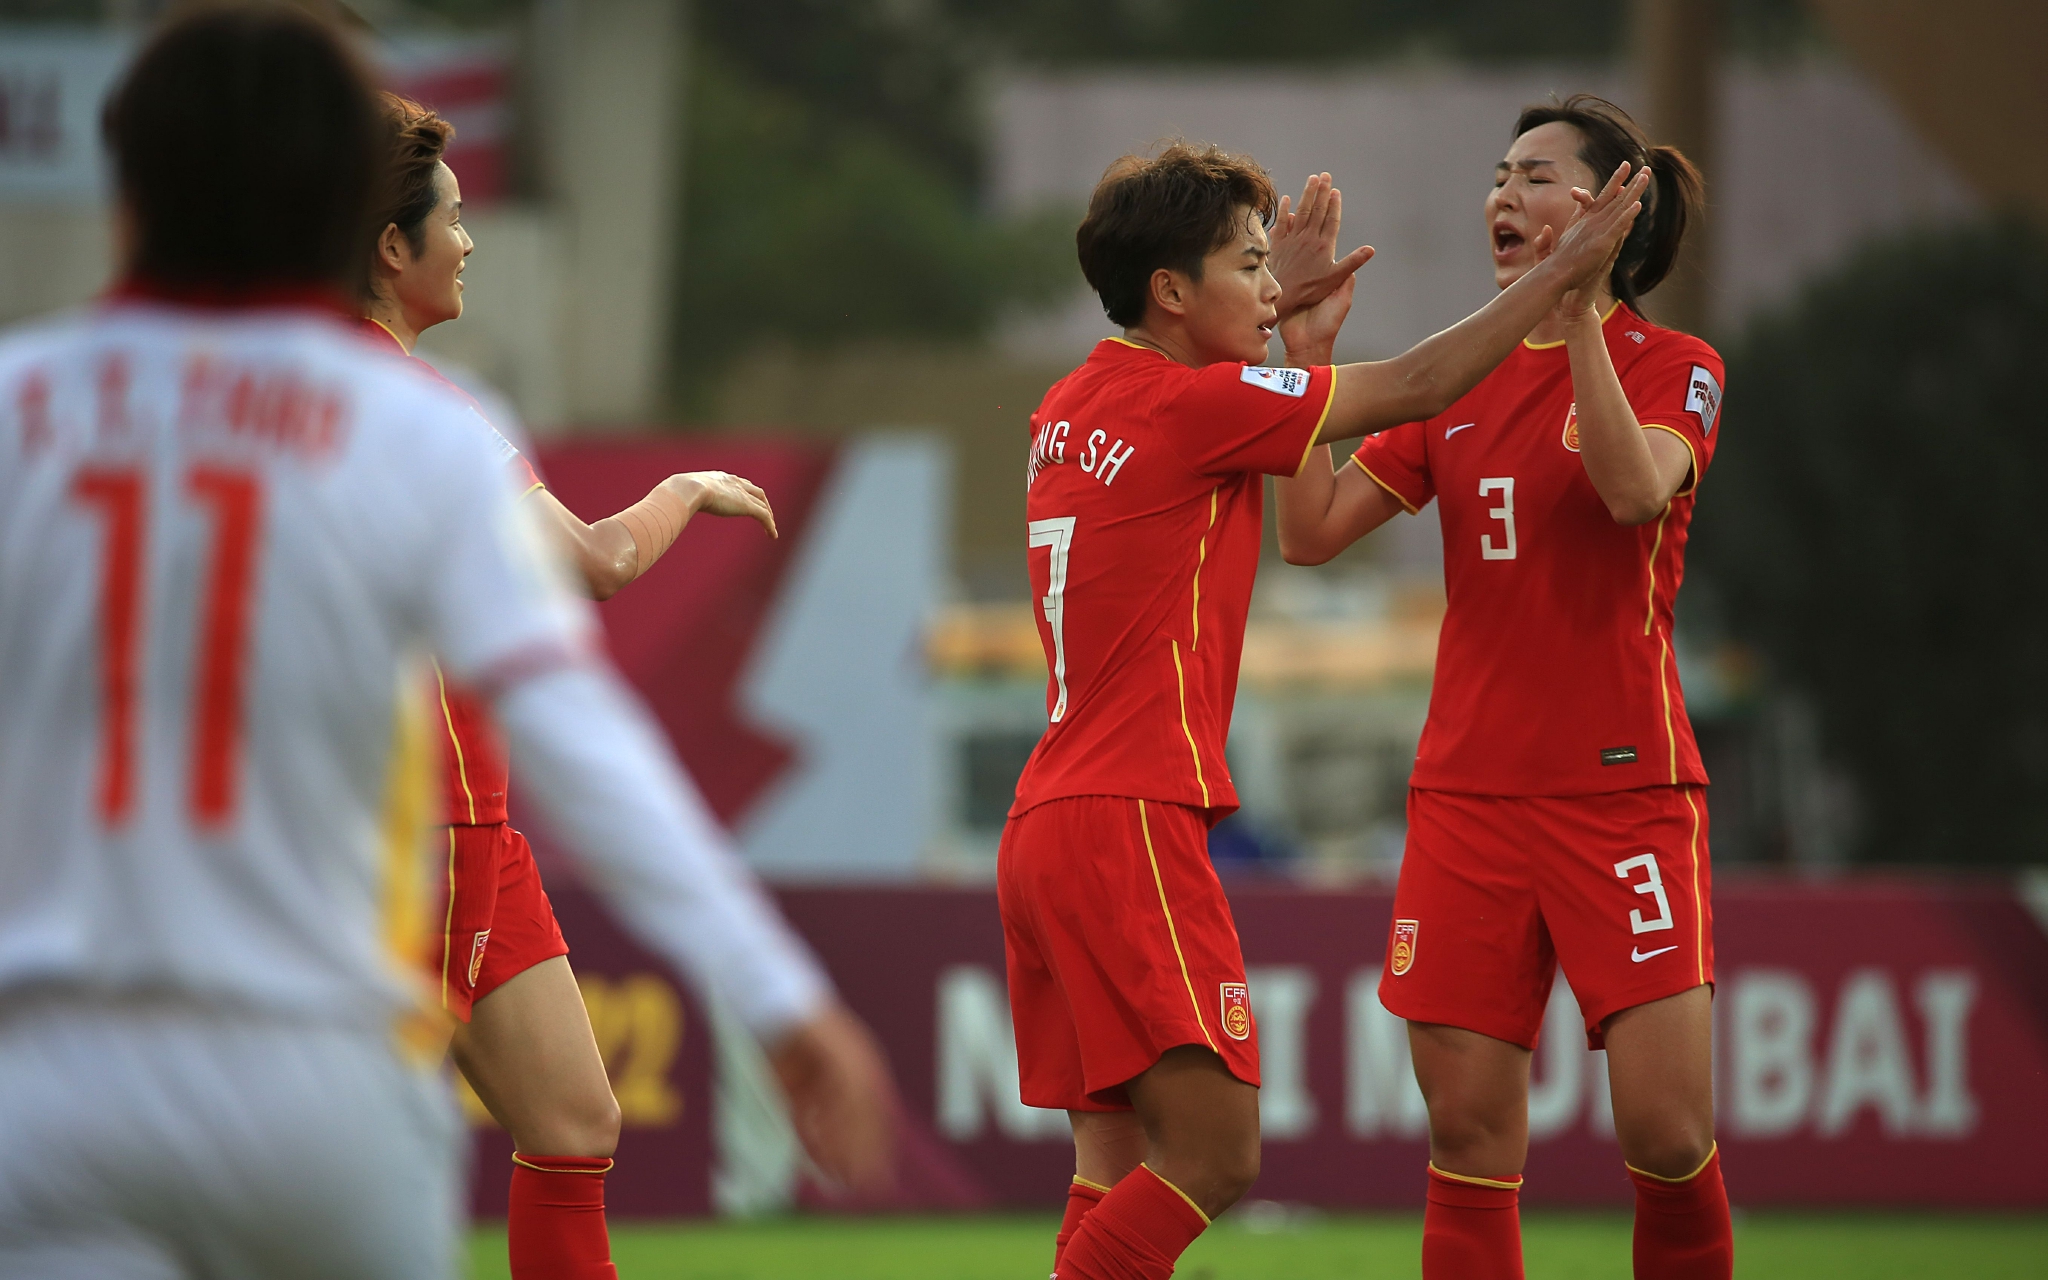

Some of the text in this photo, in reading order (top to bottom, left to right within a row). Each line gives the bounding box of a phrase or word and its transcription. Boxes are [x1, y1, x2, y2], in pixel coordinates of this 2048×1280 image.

[1693, 380, 1709, 393] OUR
[1079, 428, 1135, 487] SH
[1478, 477, 1517, 560] 3
[70, 466, 262, 828] 11
[1028, 516, 1077, 723] 7
[1613, 853, 1675, 935] 3
[1225, 987, 1246, 998] CFA
